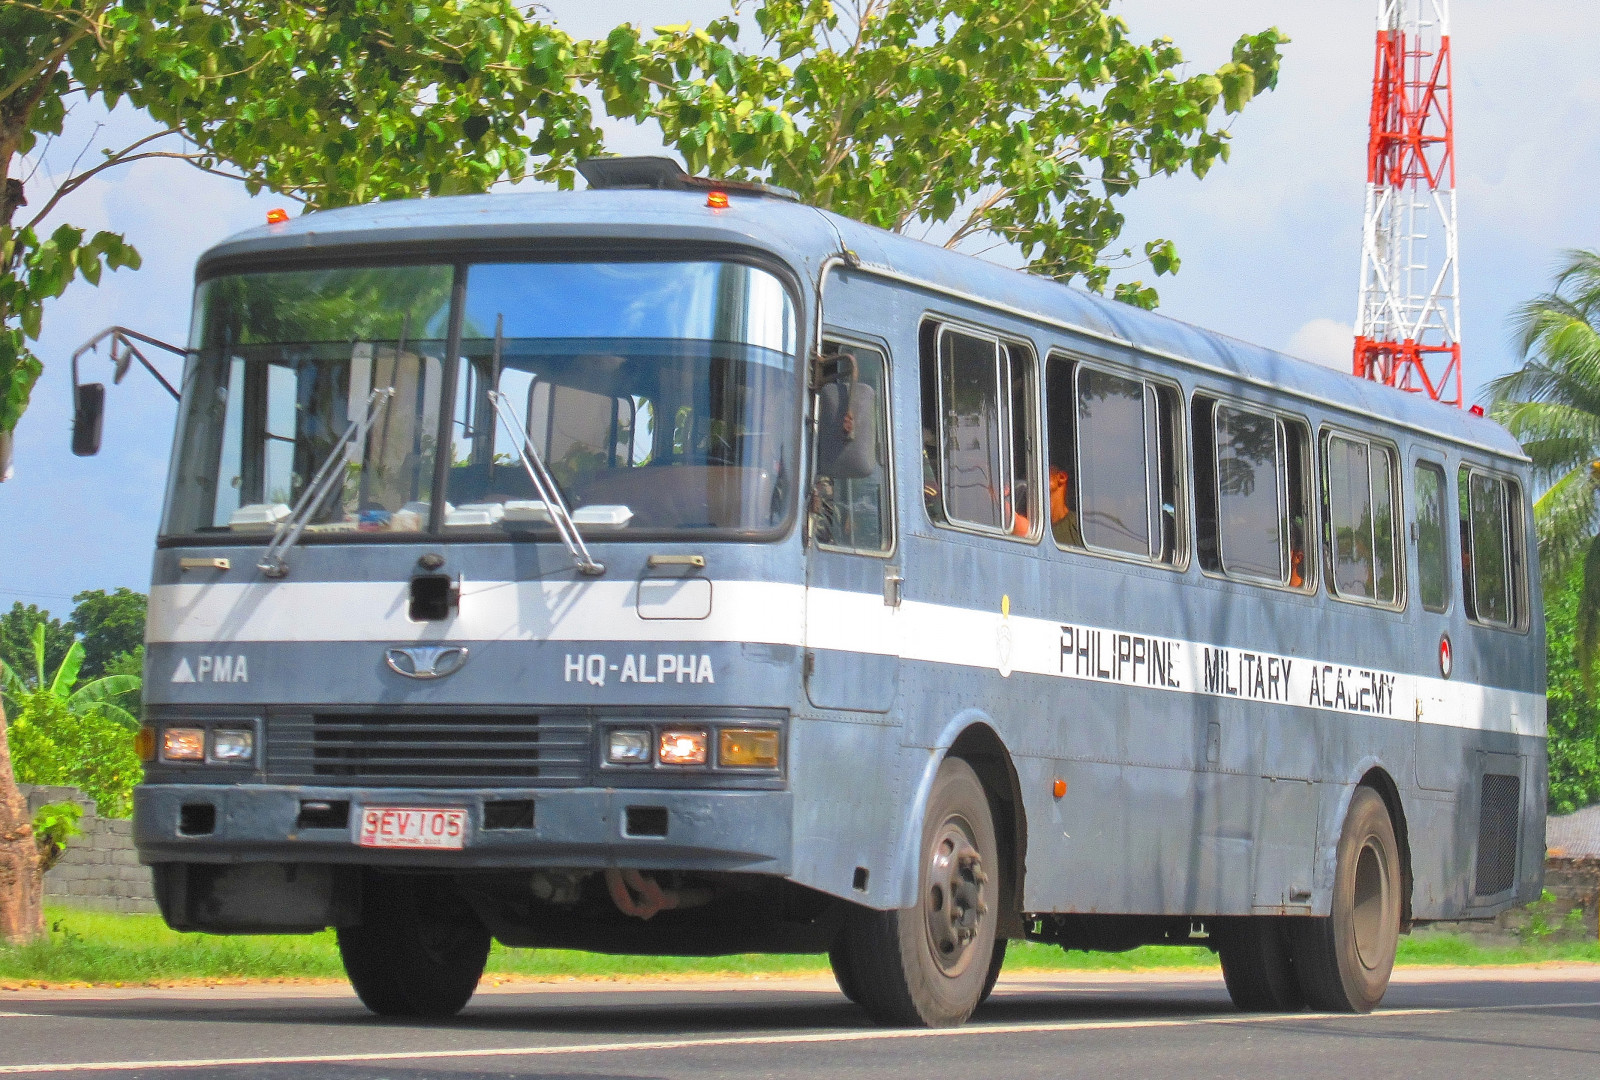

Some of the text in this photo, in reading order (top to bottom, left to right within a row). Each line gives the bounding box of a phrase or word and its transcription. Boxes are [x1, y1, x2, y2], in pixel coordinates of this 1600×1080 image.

[197, 655, 249, 682] PMA
[564, 653, 715, 687] HQ-ALPHA
[1060, 625, 1181, 688] PHILIPPINE
[1204, 647, 1292, 702] MILITARY
